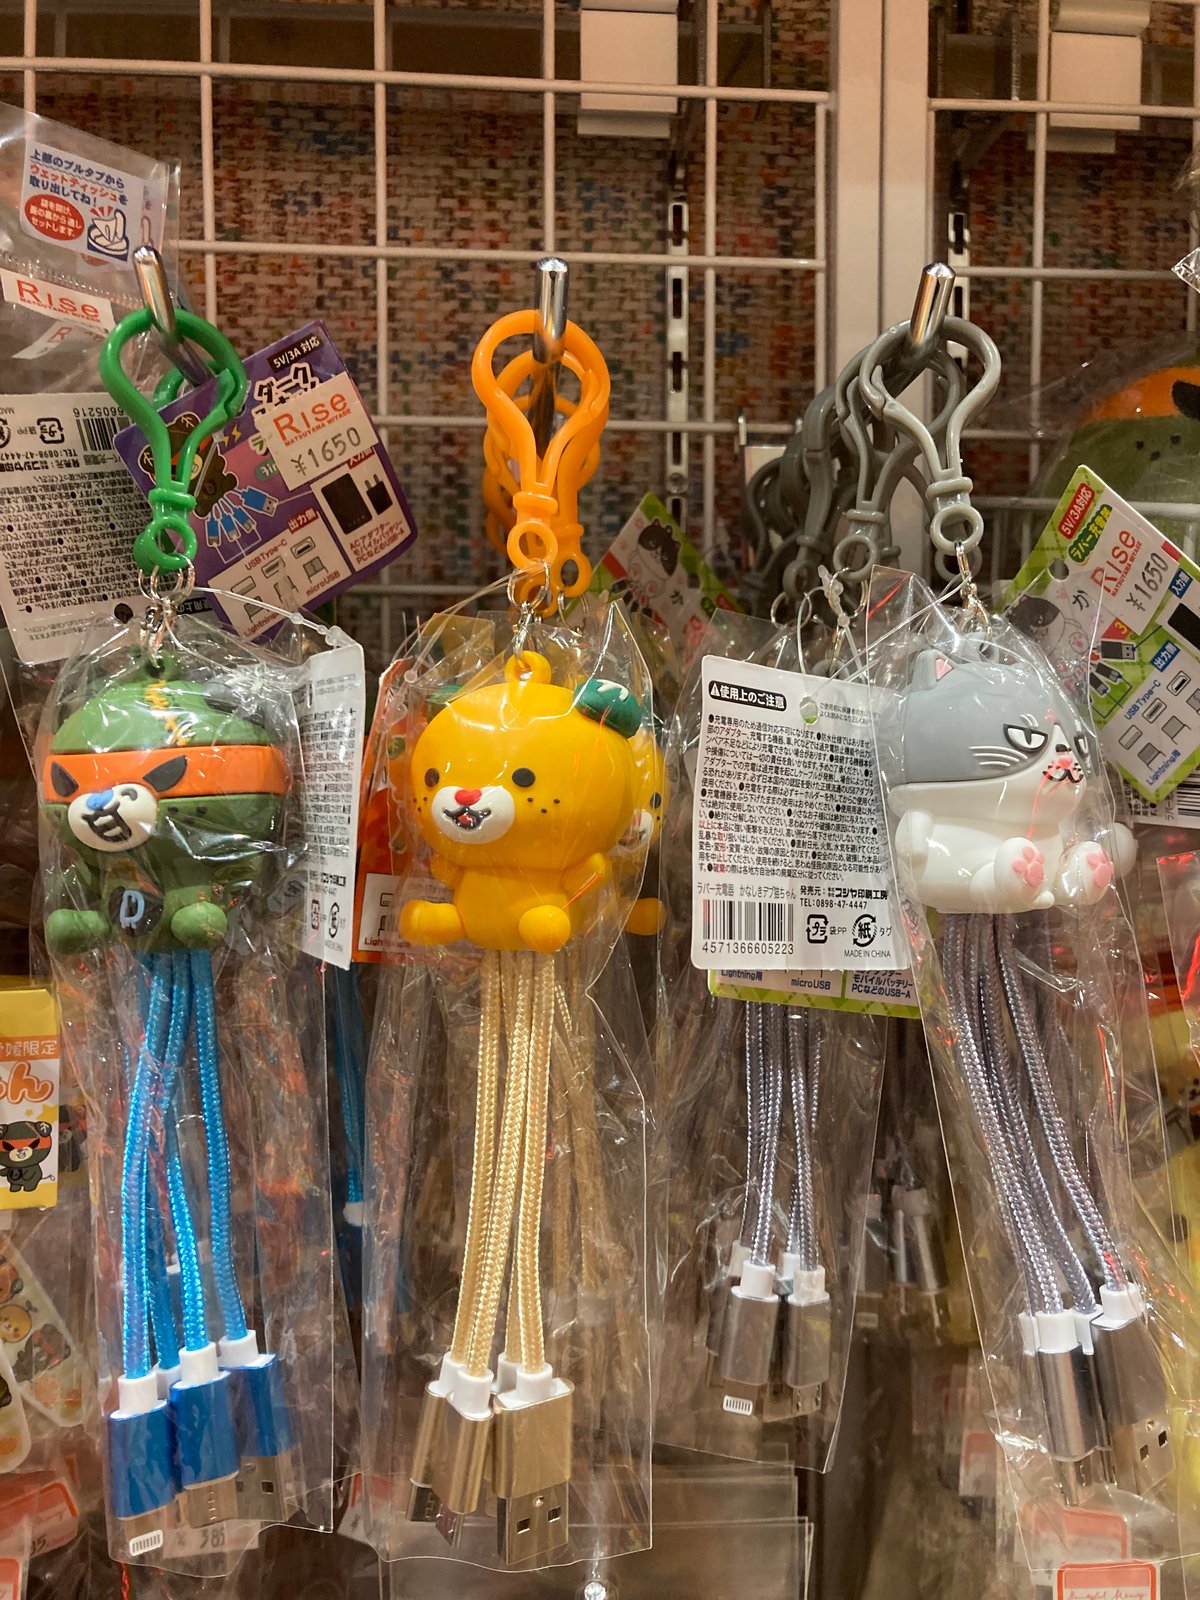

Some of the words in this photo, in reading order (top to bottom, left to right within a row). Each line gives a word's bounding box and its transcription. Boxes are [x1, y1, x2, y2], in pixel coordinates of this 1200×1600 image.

[273, 393, 348, 442] Rise
[1090, 530, 1136, 594] Rise
[720, 685, 785, 710] 使用上のご注意
[800, 898, 868, 910] TEL:0898-47-4447
[811, 921, 826, 936] プラ
[857, 921, 871, 939] 紙
[702, 941, 794, 955] 4571366605223
[844, 949, 862, 957] MADE
[863, 949, 870, 957] IN
[871, 950, 891, 958] CHINA
[853, 974, 913, 989] モバイルバッテリー
